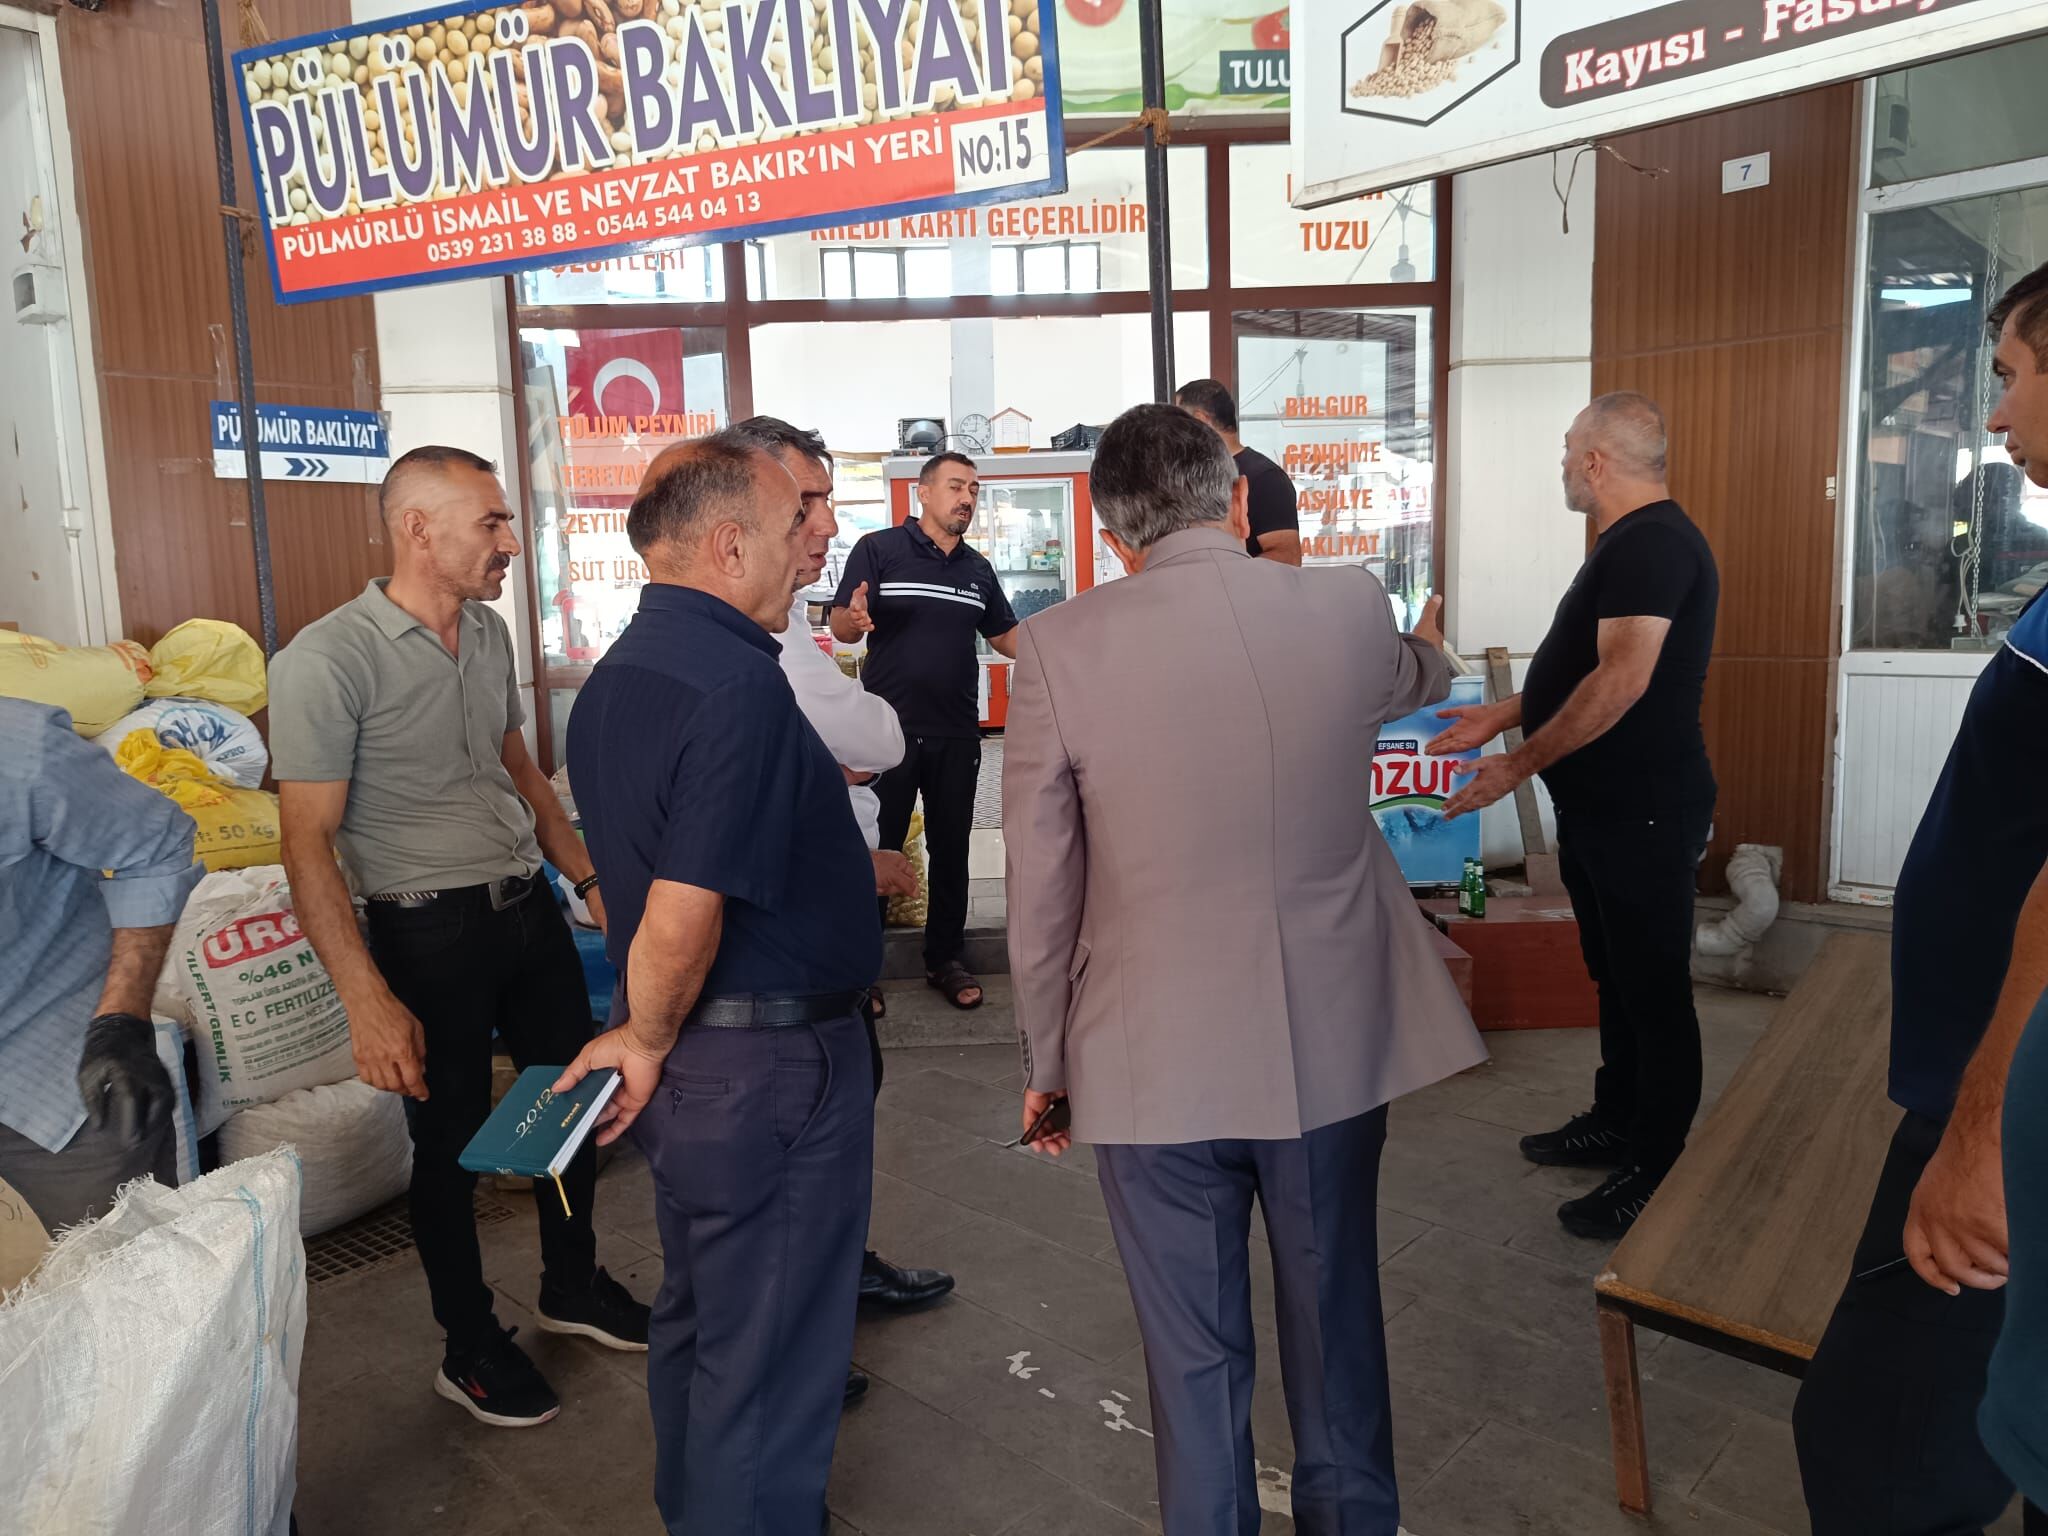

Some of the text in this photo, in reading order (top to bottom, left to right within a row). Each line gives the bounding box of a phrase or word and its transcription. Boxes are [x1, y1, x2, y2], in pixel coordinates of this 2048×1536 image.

[1564, 28, 1706, 93] Kayısı
[254, 11, 612, 221] PÜLÜMÜR
[959, 118, 1031, 177] NO:15
[1740, 164, 1752, 182] 7
[282, 208, 424, 261] PÜLMÜRLÜ
[433, 192, 529, 236] İSMAİL
[534, 189, 572, 218] VE
[580, 165, 700, 212] NEVZAT
[864, 118, 943, 164] YERİ
[427, 239, 474, 263] 0539
[479, 232, 513, 255] 231
[522, 227, 546, 248] 38
[552, 222, 577, 244] 88
[597, 211, 648, 237] 0544
[654, 203, 694, 227] 544
[700, 197, 727, 219] 04
[735, 192, 760, 213] 13
[901, 208, 976, 238] KARTI
[987, 197, 1145, 240] GEÇERLİDİR
[1300, 220, 1368, 251] TUZU
[1285, 395, 1368, 417] BULGUR
[304, 415, 378, 449] BAKLİYAT
[556, 409, 716, 439] TULUM PEYNİRİ
[1284, 438, 1381, 465] GENDİME
[569, 556, 605, 582] SÜT
[1378, 741, 1415, 751] EFSANE SU
[219, 824, 245, 840] 50
[239, 960, 292, 985] %46
[296, 950, 314, 967] N
